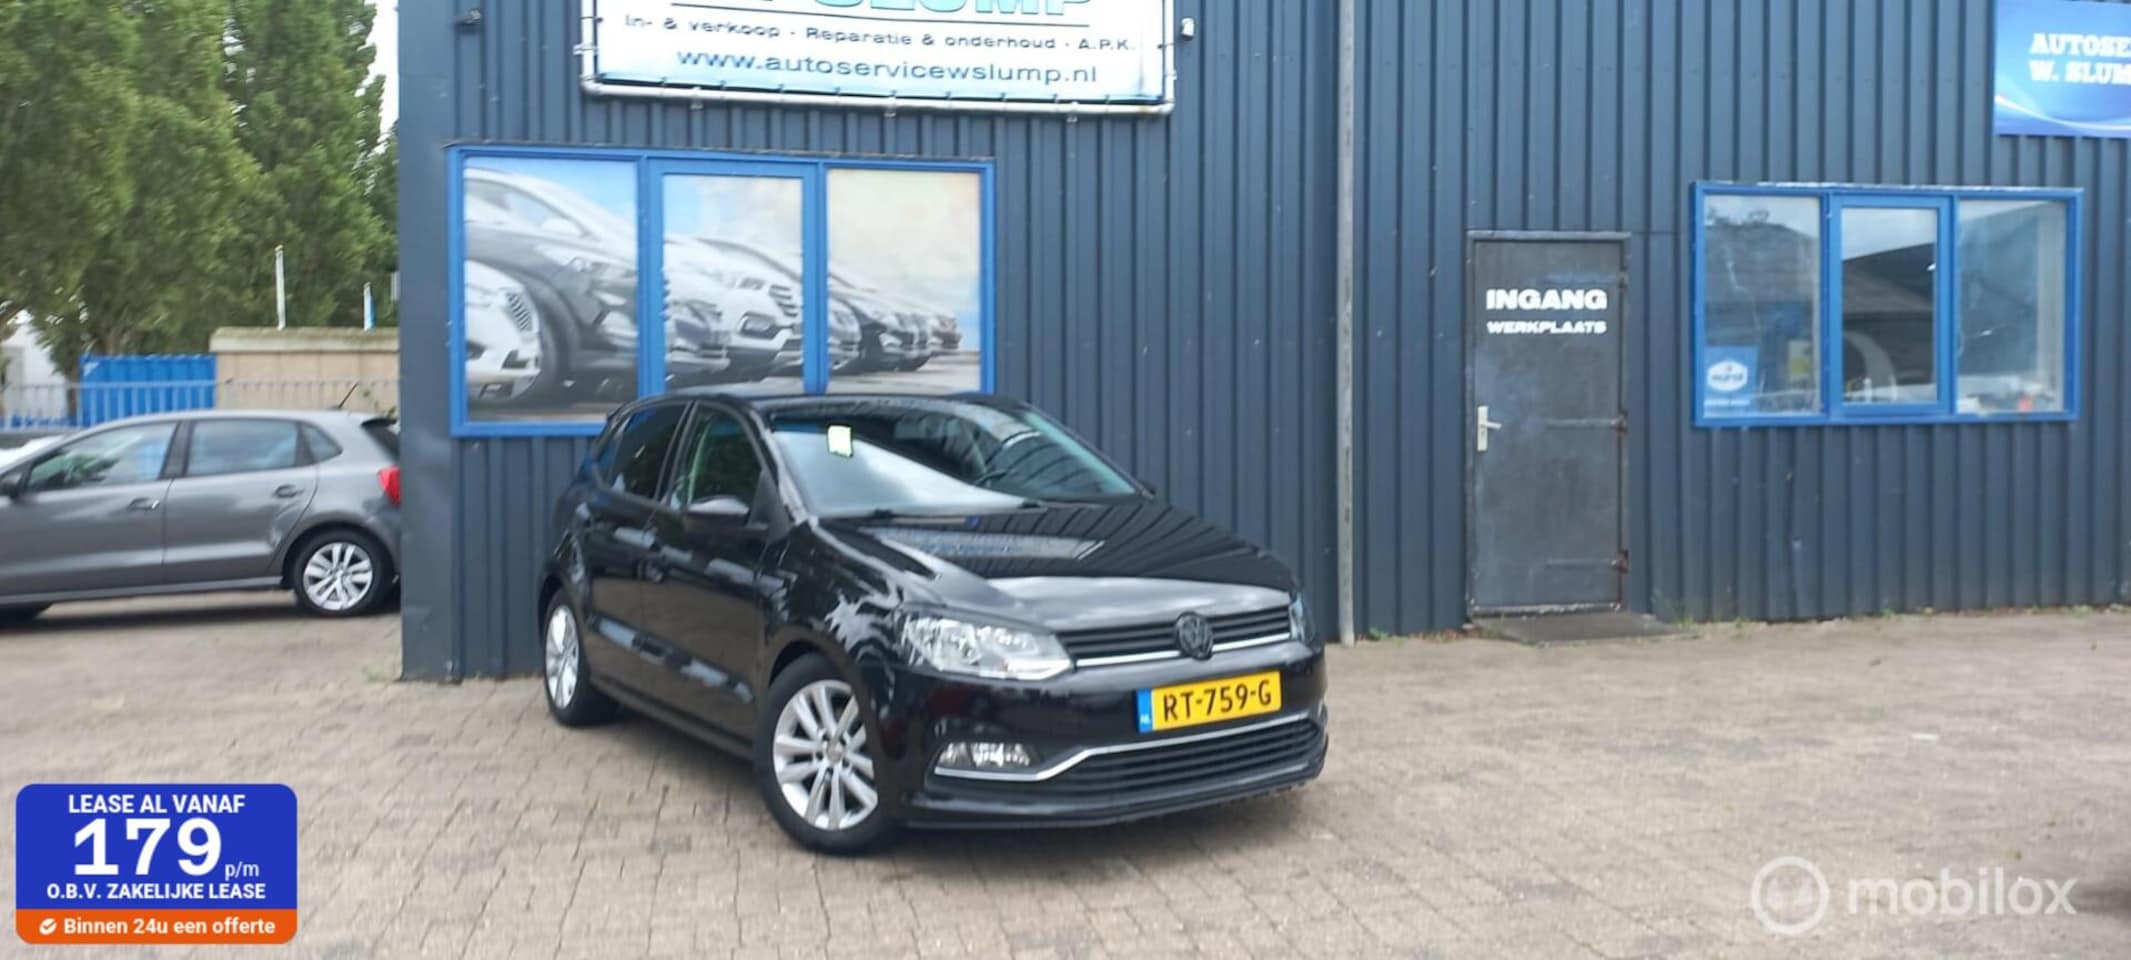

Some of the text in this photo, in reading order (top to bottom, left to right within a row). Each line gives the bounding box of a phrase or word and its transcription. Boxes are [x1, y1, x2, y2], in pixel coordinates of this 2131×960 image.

[625, 14, 1136, 51] In- & verkoop Reparatie & onderhoud A.P.K.
[677, 51, 1097, 85] www.autoservicewslump.nl
[2028, 60, 2060, 81] W.
[1486, 288, 1608, 310] INGANG
[1486, 320, 1608, 335] WERKPLAATS
[1163, 680, 1272, 722] RT-759-G
